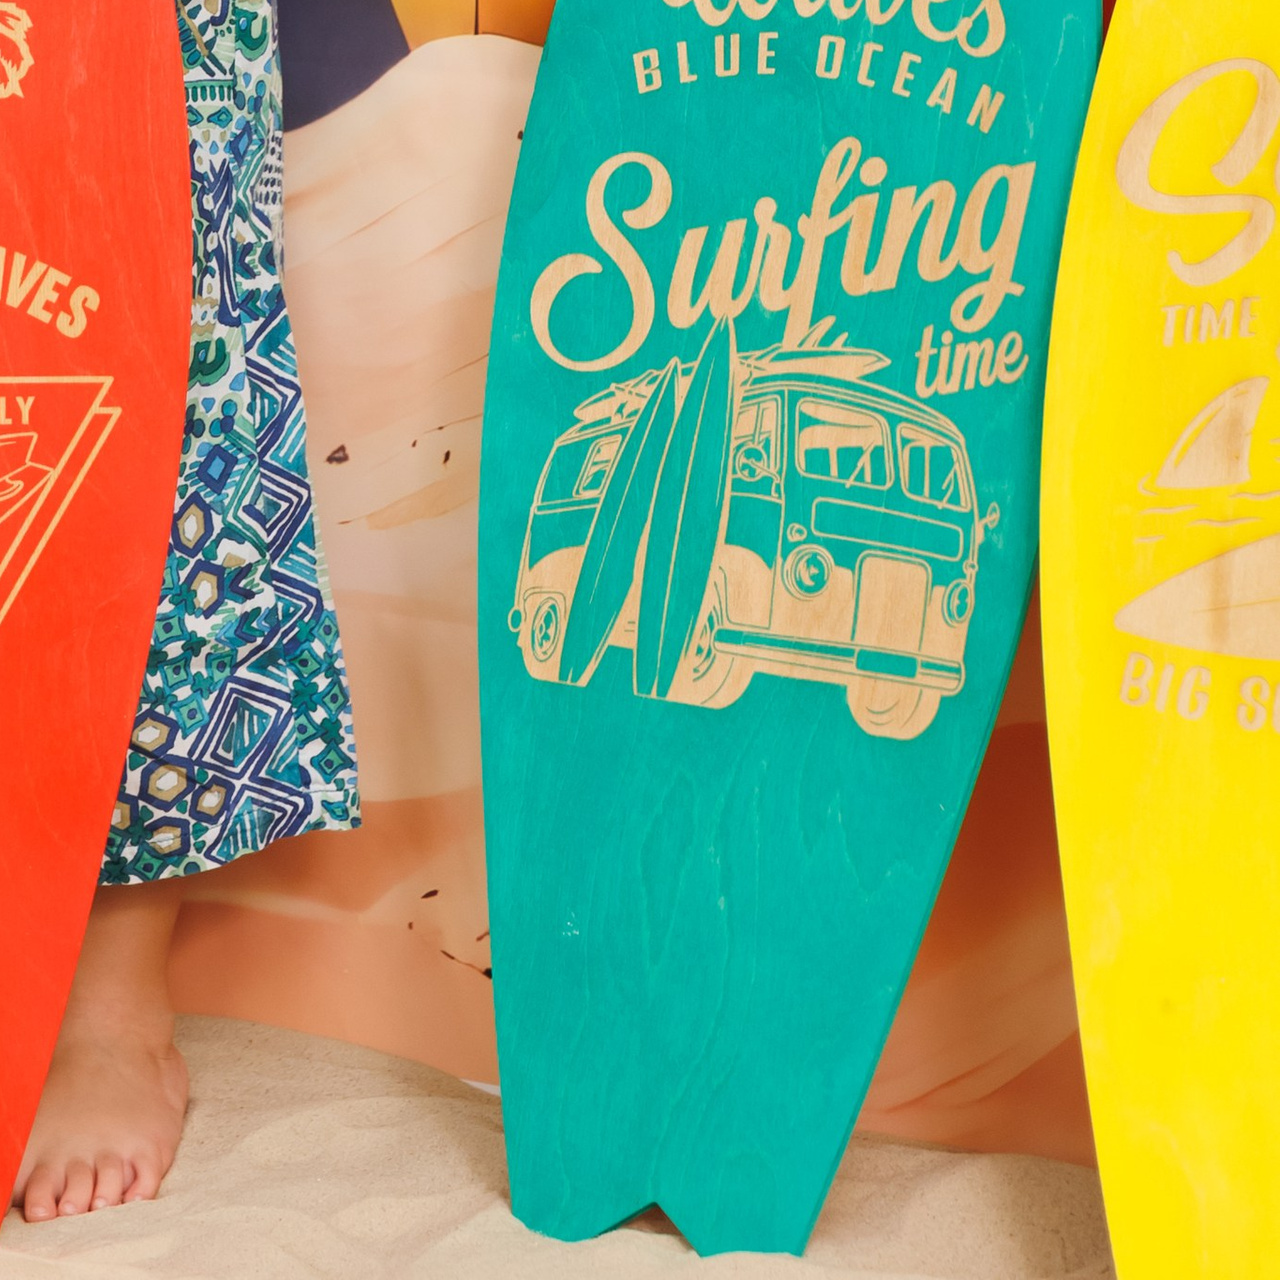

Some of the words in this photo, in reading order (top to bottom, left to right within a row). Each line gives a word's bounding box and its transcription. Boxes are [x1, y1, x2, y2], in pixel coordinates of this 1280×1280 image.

[632, 31, 779, 94] BLUE
[815, 34, 1005, 134] OCEAN
[529, 136, 1037, 372] Surfing
[1161, 295, 1261, 348] TIME
[914, 324, 1029, 399] time
[1119, 651, 1212, 722] BIG
